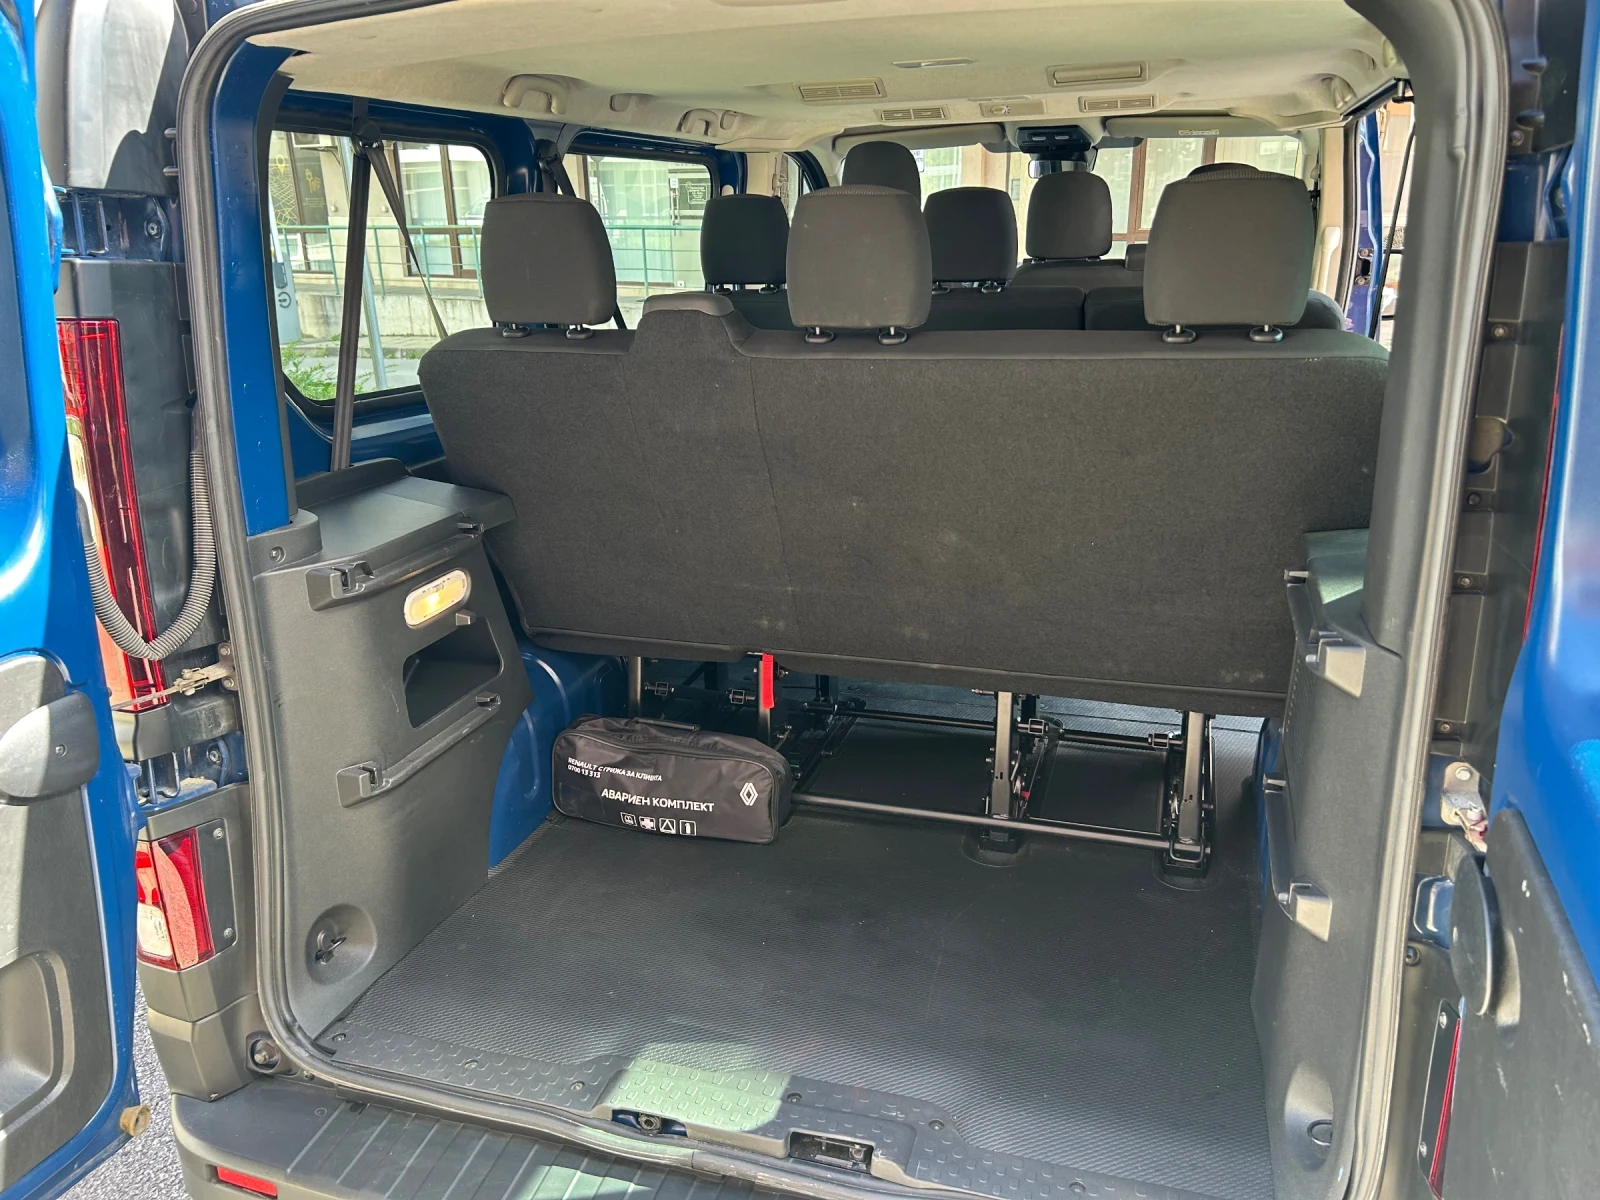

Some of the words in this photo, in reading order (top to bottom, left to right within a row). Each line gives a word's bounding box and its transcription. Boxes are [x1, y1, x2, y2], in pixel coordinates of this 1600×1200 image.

[567, 764, 581, 774] 0700
[589, 770, 601, 779] 313
[568, 757, 598, 771] RENAULT
[603, 766, 626, 776] ГРИЖА
[626, 770, 636, 778] ЗА
[601, 788, 651, 806] АВАРИЕН
[652, 797, 715, 812] КОМПЛЕКТ
